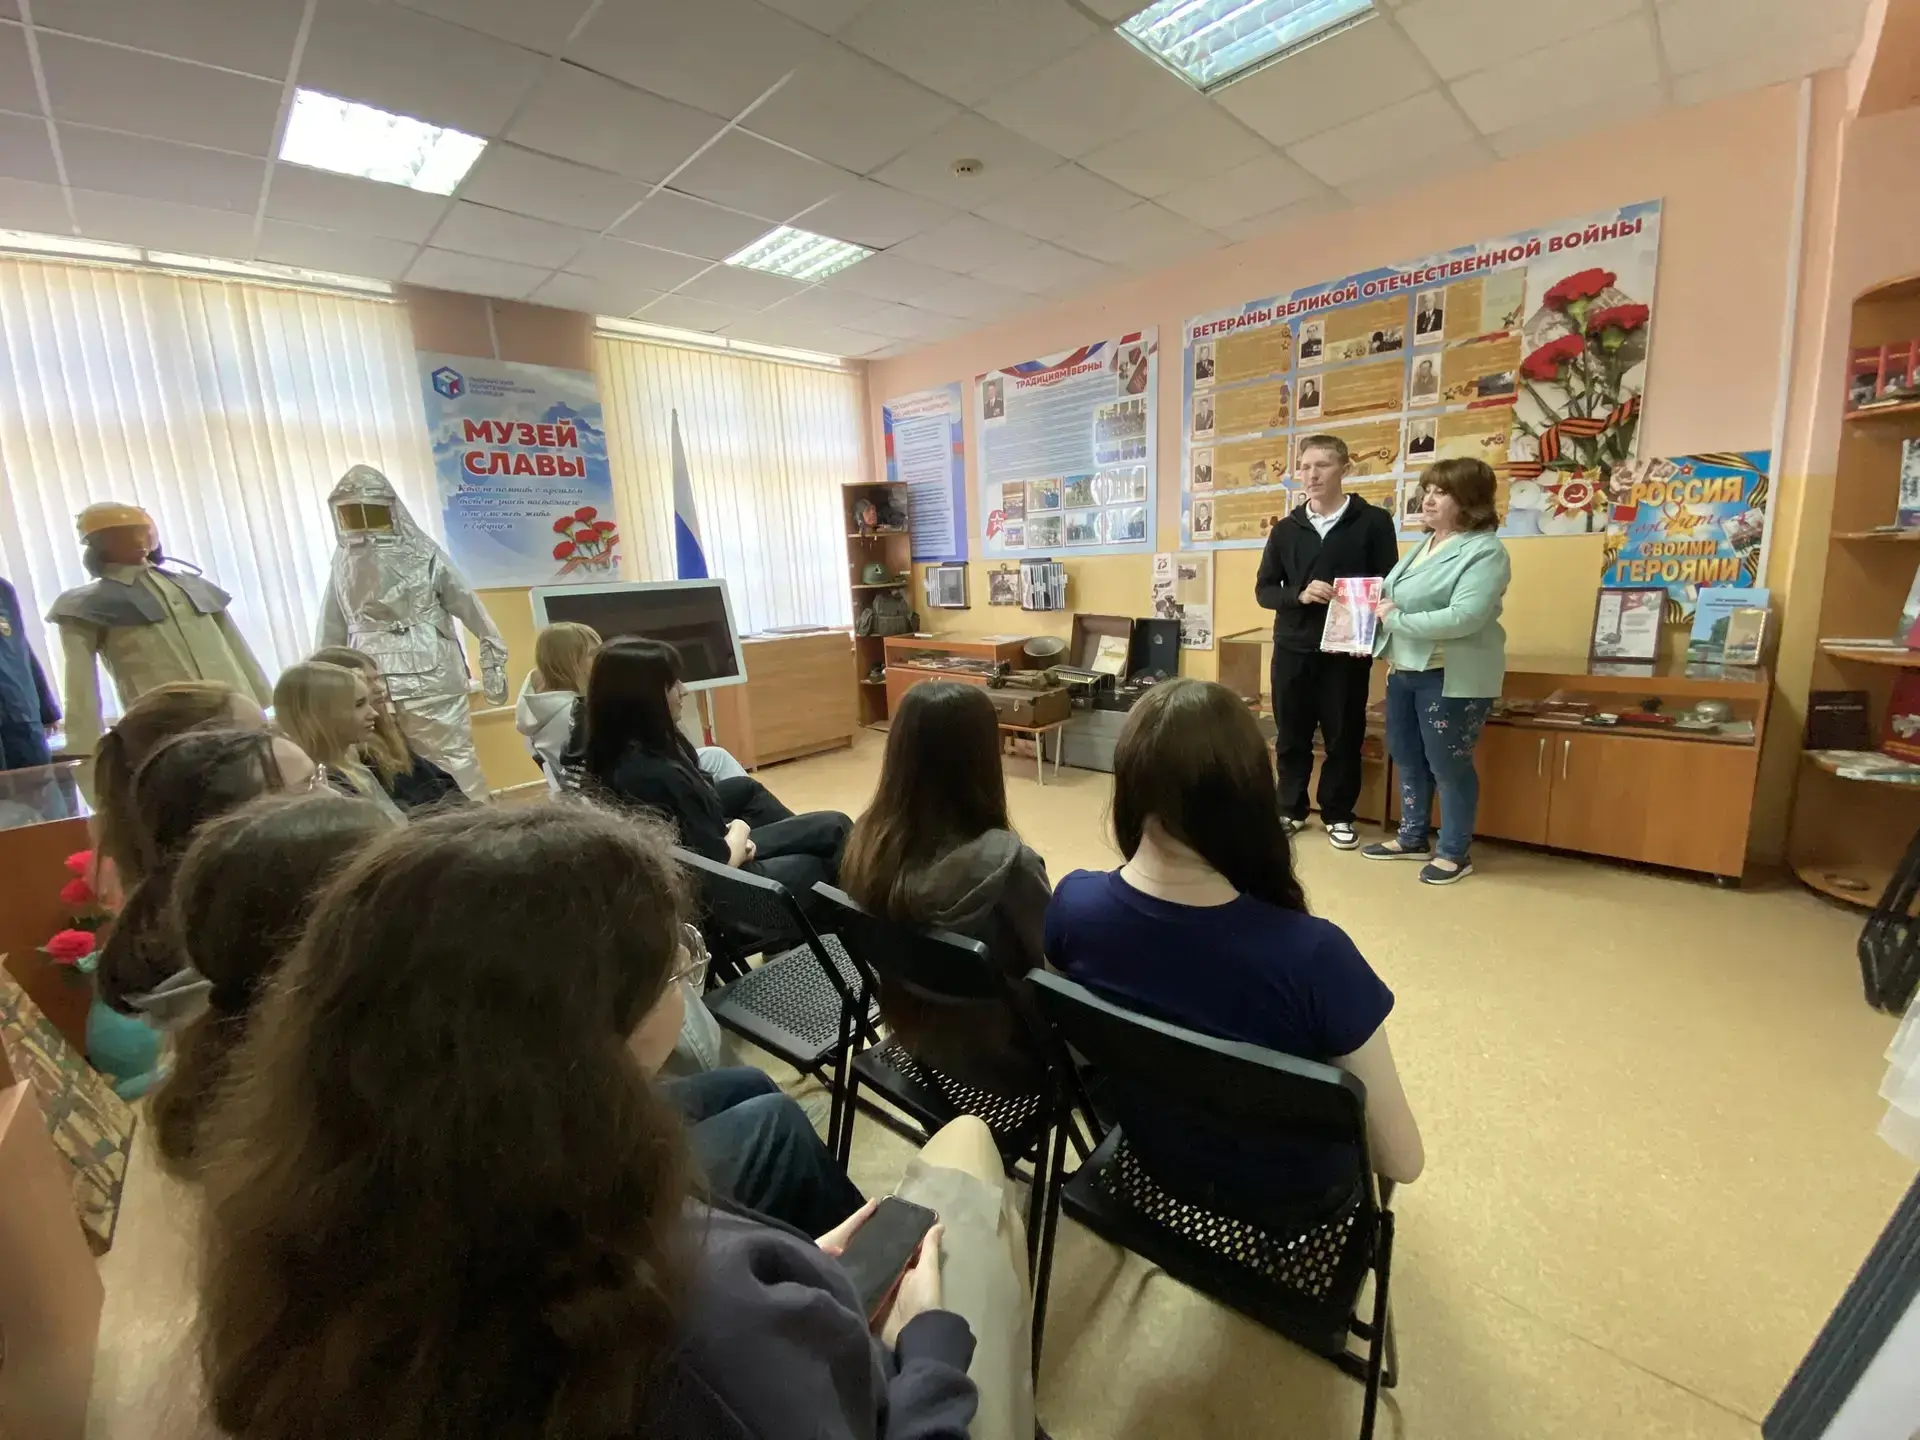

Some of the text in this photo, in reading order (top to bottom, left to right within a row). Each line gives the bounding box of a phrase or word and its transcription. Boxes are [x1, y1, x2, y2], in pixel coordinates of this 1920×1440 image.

[1192, 217, 1643, 339] ВЕТЕРАНЫ ВЕЛИКОЙ ОТЕЧЕСТВЕННОЙ ВОЙНЫ
[1015, 361, 1103, 389] ТРАДИЦИЯМ ВЕРНЫ
[463, 418, 578, 448] МУЗЕЙ
[464, 451, 586, 478] СЛАВЫ
[1630, 476, 1744, 508] РОССИЯ
[1640, 540, 1718, 557] СВОИМИ
[1616, 557, 1742, 583] ГЕРОЯМИ
